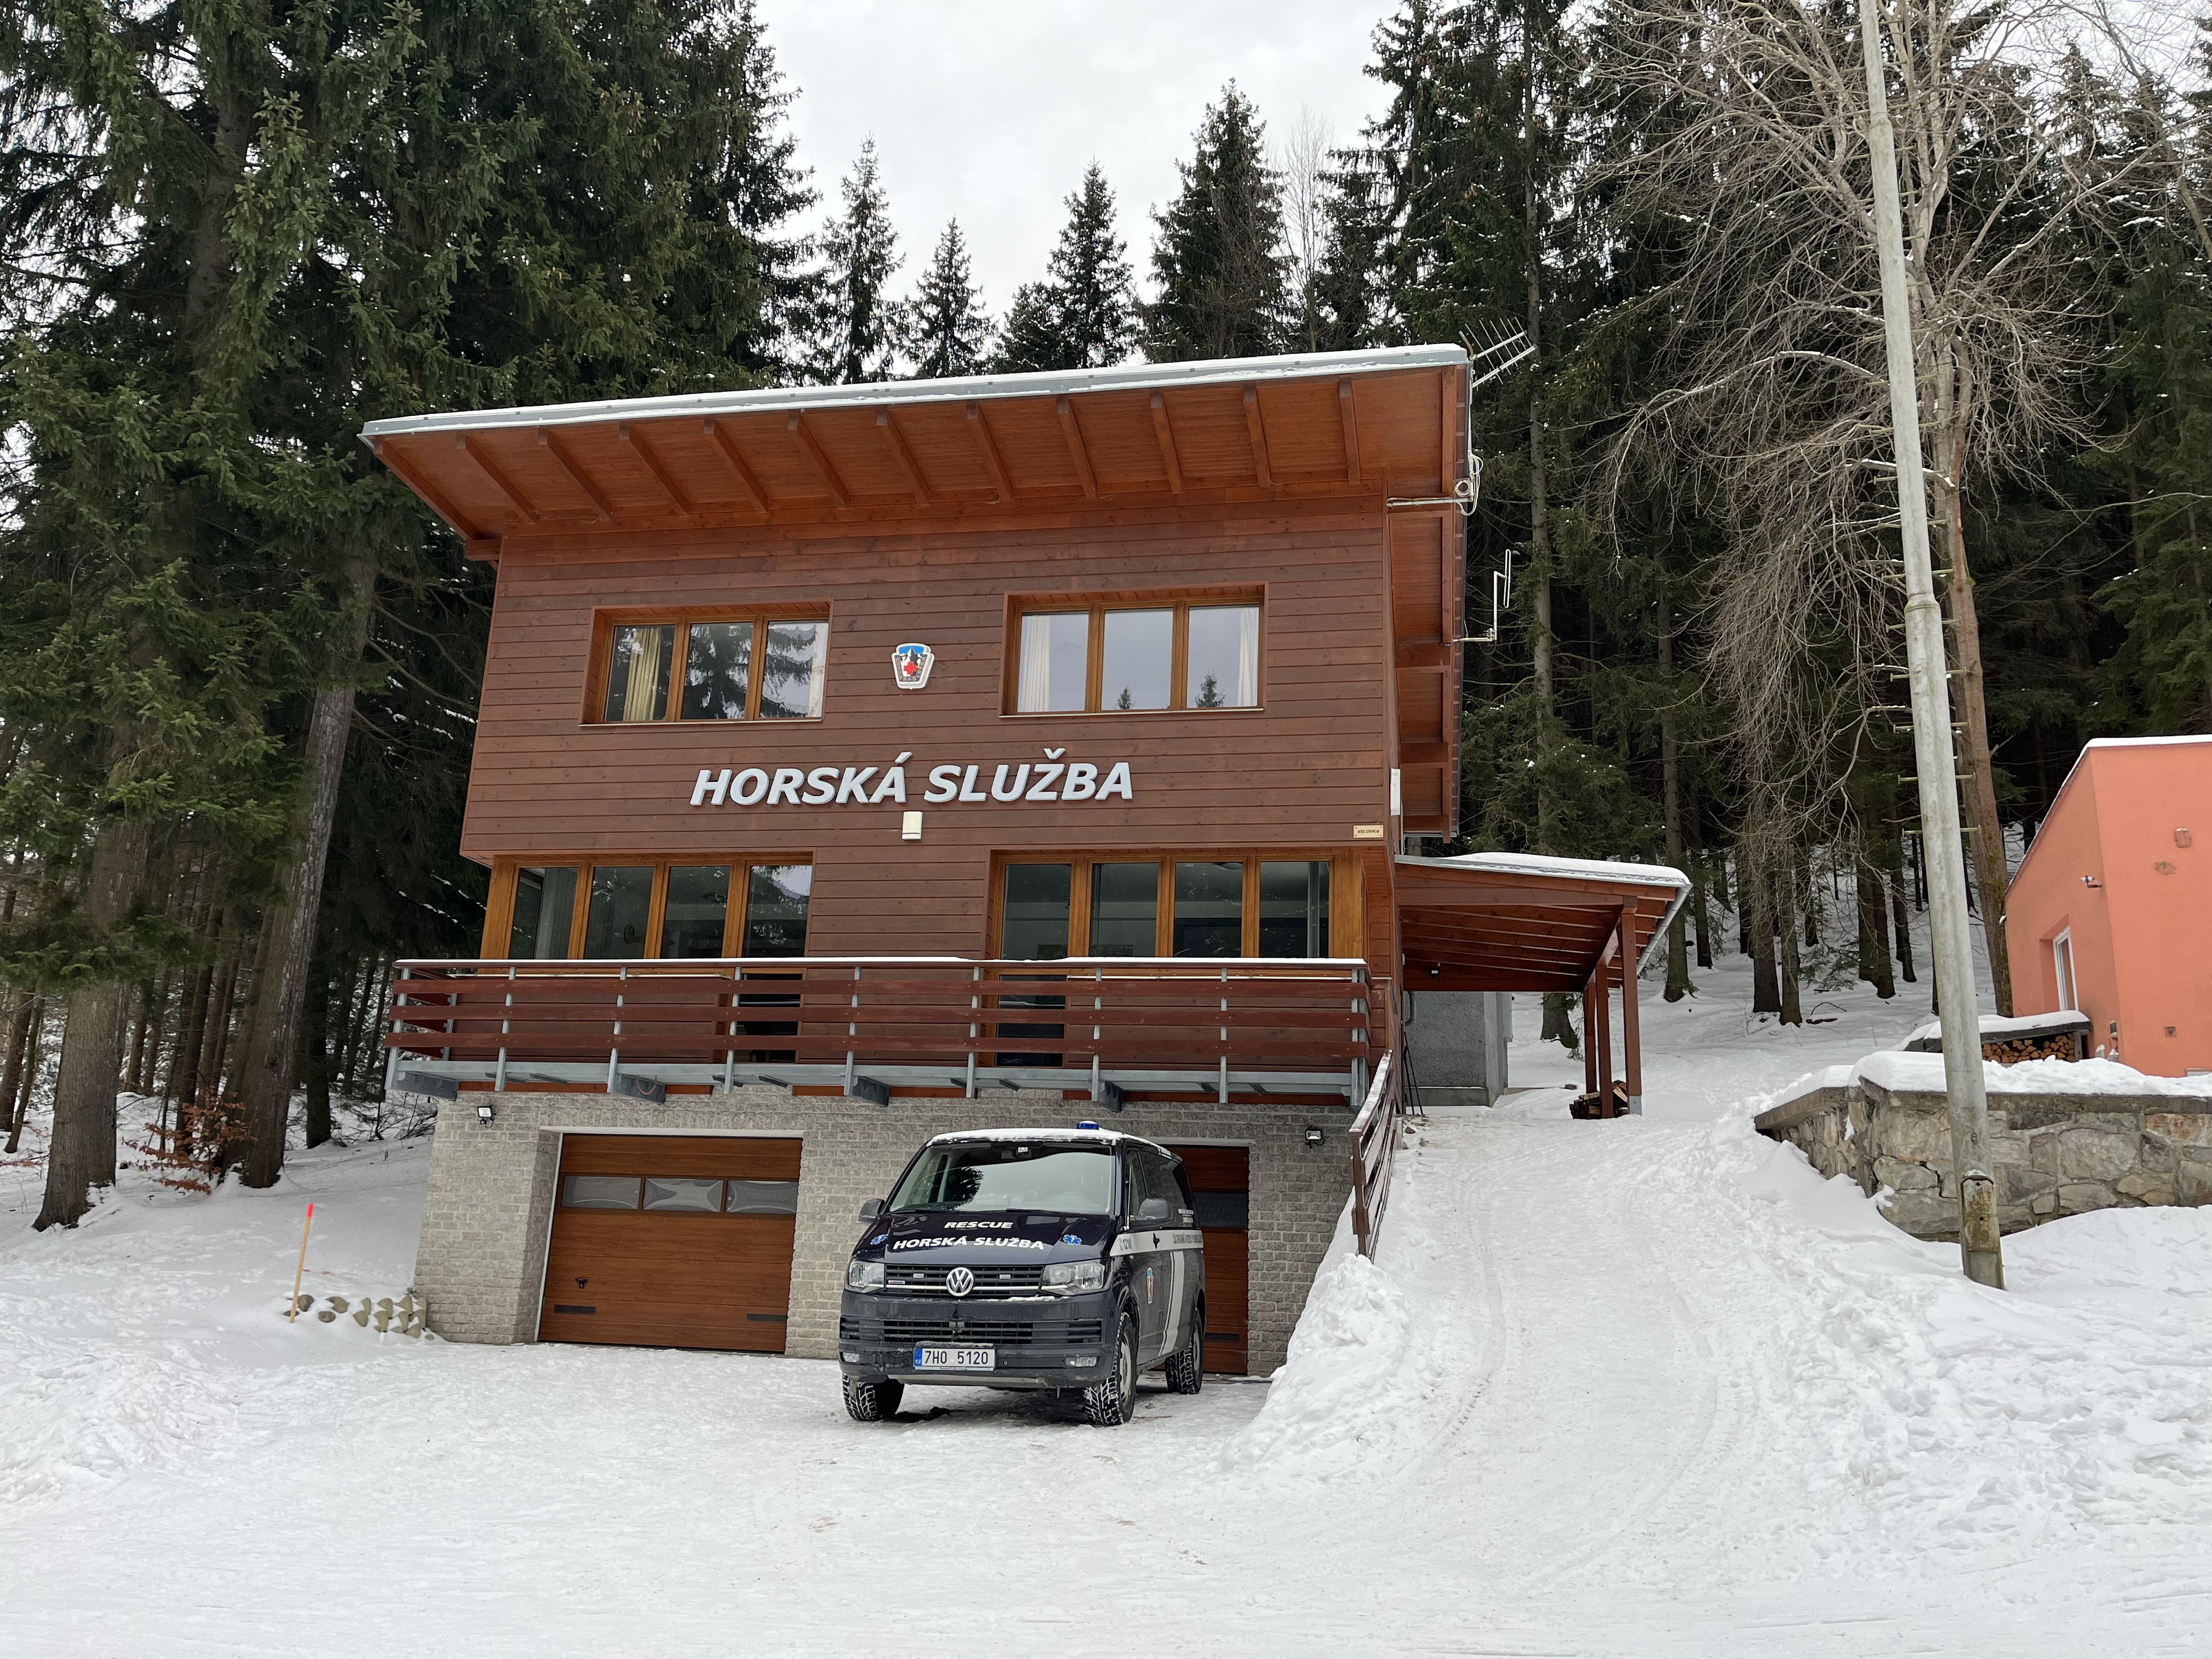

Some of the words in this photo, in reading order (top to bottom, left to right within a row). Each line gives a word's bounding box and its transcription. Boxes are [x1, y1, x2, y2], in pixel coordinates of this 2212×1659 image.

[690, 752, 912, 805] HORSKÁ
[924, 748, 1133, 802] SLUŽBA
[944, 1221, 1014, 1229] RESCUE
[893, 1235, 968, 1250] HORSKÁ
[973, 1237, 1045, 1250] SLUŽBA
[925, 1350, 947, 1364] 7H0
[957, 1351, 988, 1365] 5120
